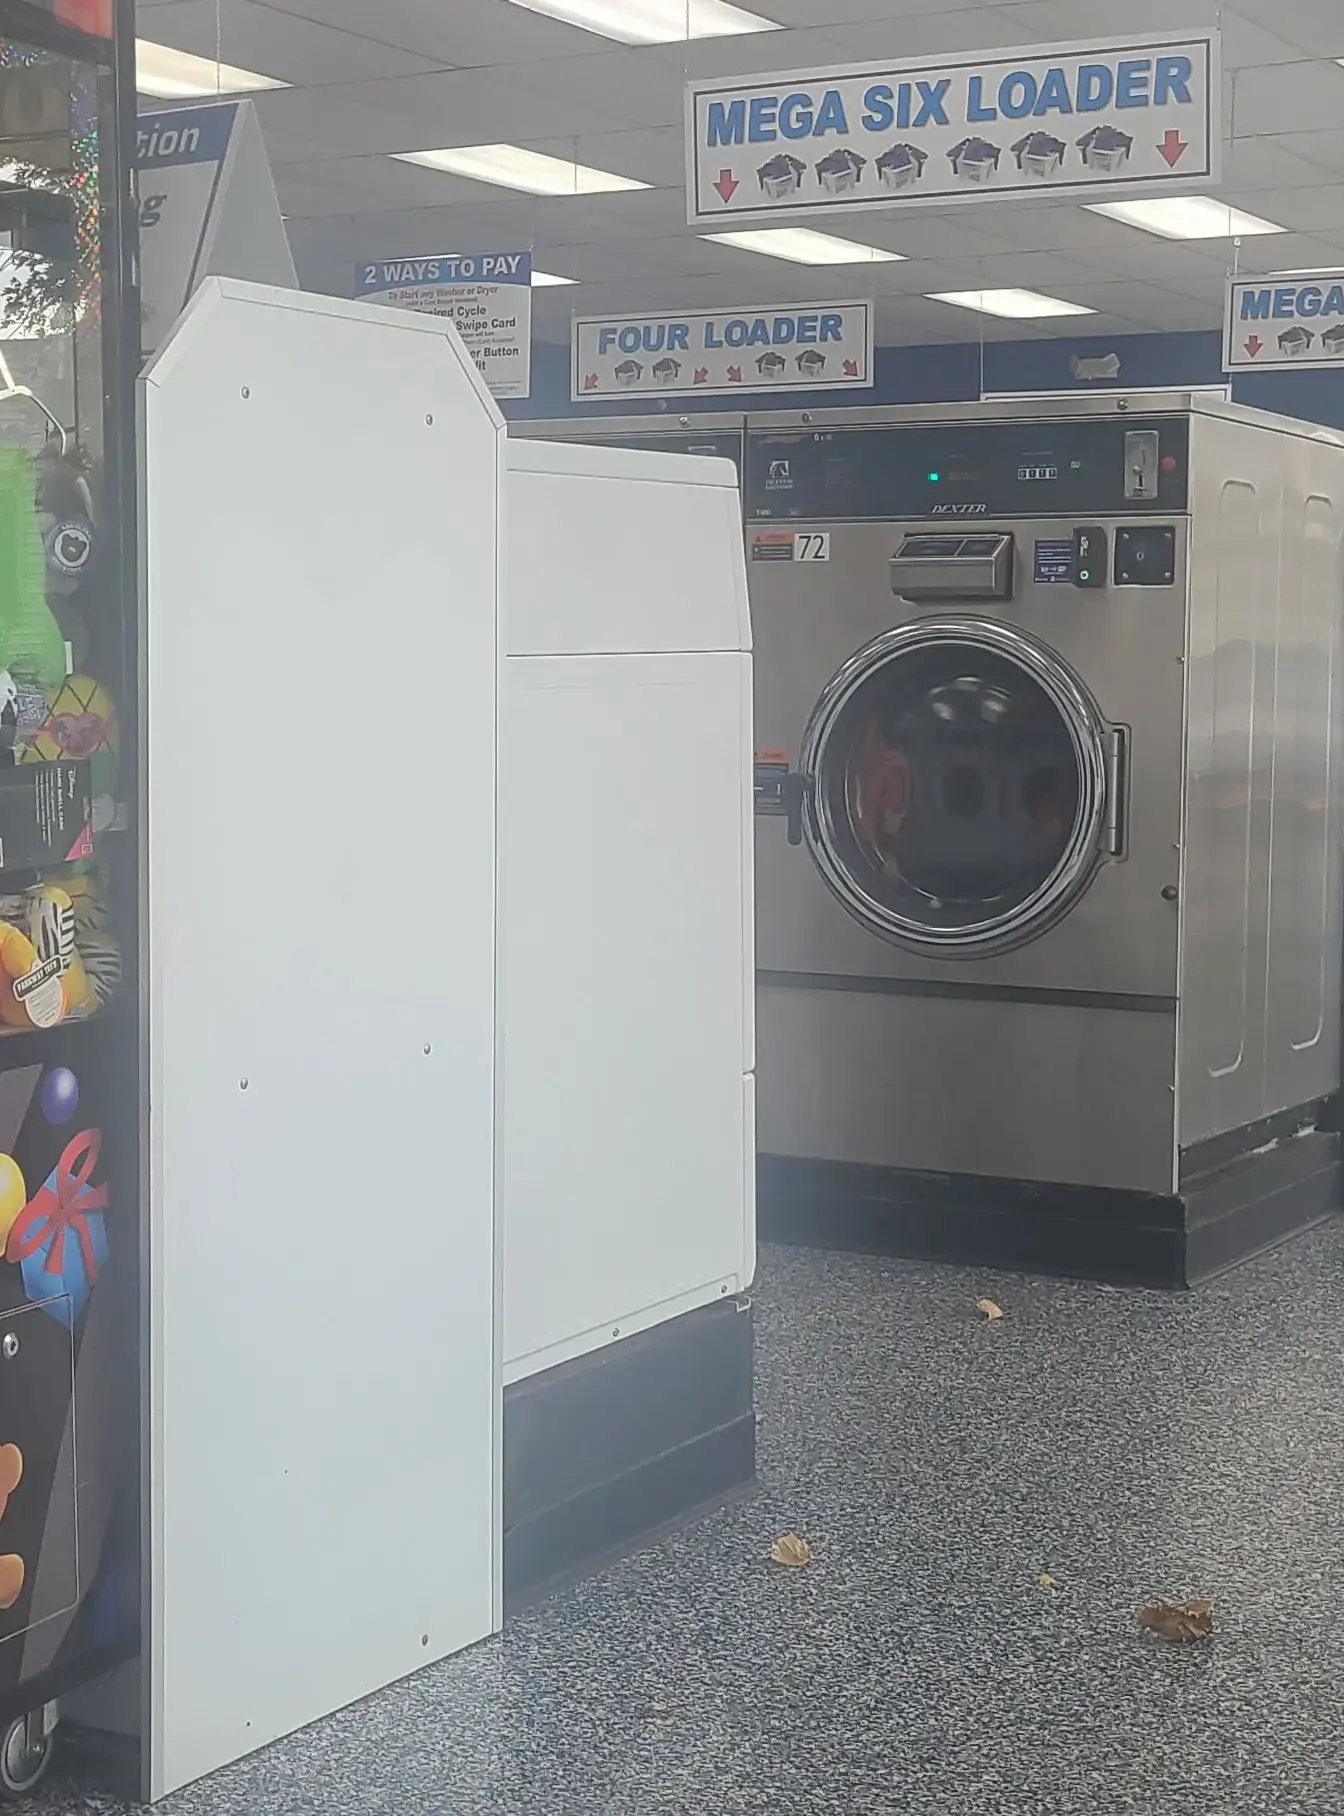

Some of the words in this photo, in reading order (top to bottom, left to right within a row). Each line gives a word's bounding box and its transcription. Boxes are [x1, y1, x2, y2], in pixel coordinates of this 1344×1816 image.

[706, 90, 848, 148] MEGA
[861, 79, 951, 132] SIX
[966, 55, 1194, 123] LOADER
[364, 266, 376, 284] 2
[383, 262, 441, 282] WAYS
[447, 258, 476, 278] TO
[482, 255, 522, 276] PAY
[457, 305, 487, 319] Cycle
[456, 319, 488, 332] Swipe
[491, 316, 516, 328] Card
[598, 323, 690, 355] FOUR
[704, 313, 844, 349] LOADER
[483, 346, 519, 358] Button
[931, 503, 988, 515] DEXTER
[798, 534, 826, 560] 72
